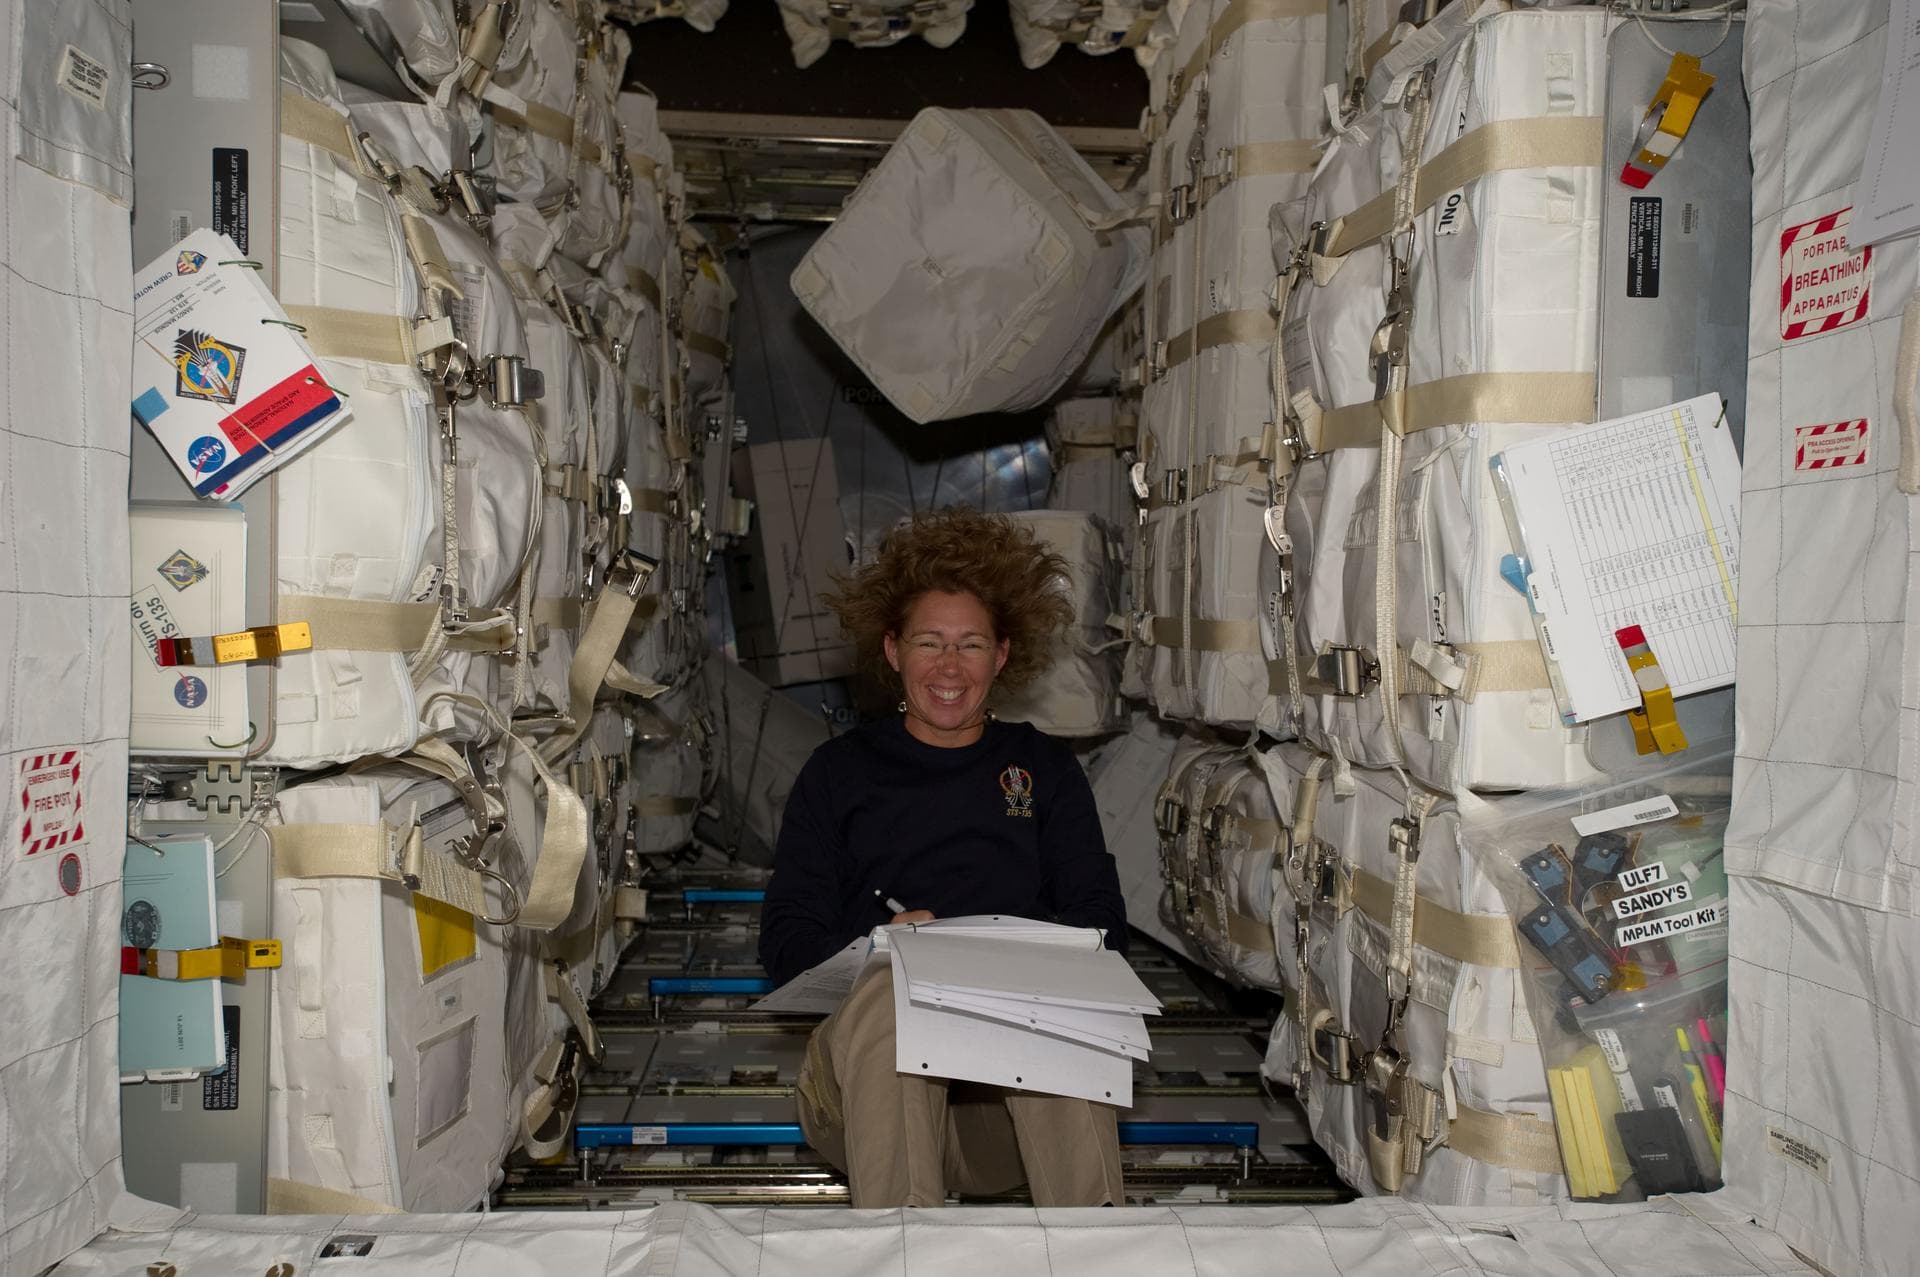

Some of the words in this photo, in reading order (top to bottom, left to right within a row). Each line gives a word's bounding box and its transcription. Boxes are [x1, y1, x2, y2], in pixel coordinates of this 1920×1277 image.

[1438, 193, 1461, 235] ONL
[152, 270, 173, 287] CREW
[1795, 255, 1861, 292] BREATHING
[1793, 286, 1858, 315] APPARATUS
[191, 442, 223, 467] NASA
[58, 768, 71, 779] USE
[34, 796, 53, 813] FIRE
[1624, 865, 1661, 887] ULF7
[1618, 885, 1688, 915] SANDY'S
[1623, 923, 1663, 942] MPLM
[1667, 917, 1694, 932] Tool
[1697, 908, 1715, 925] Kit
